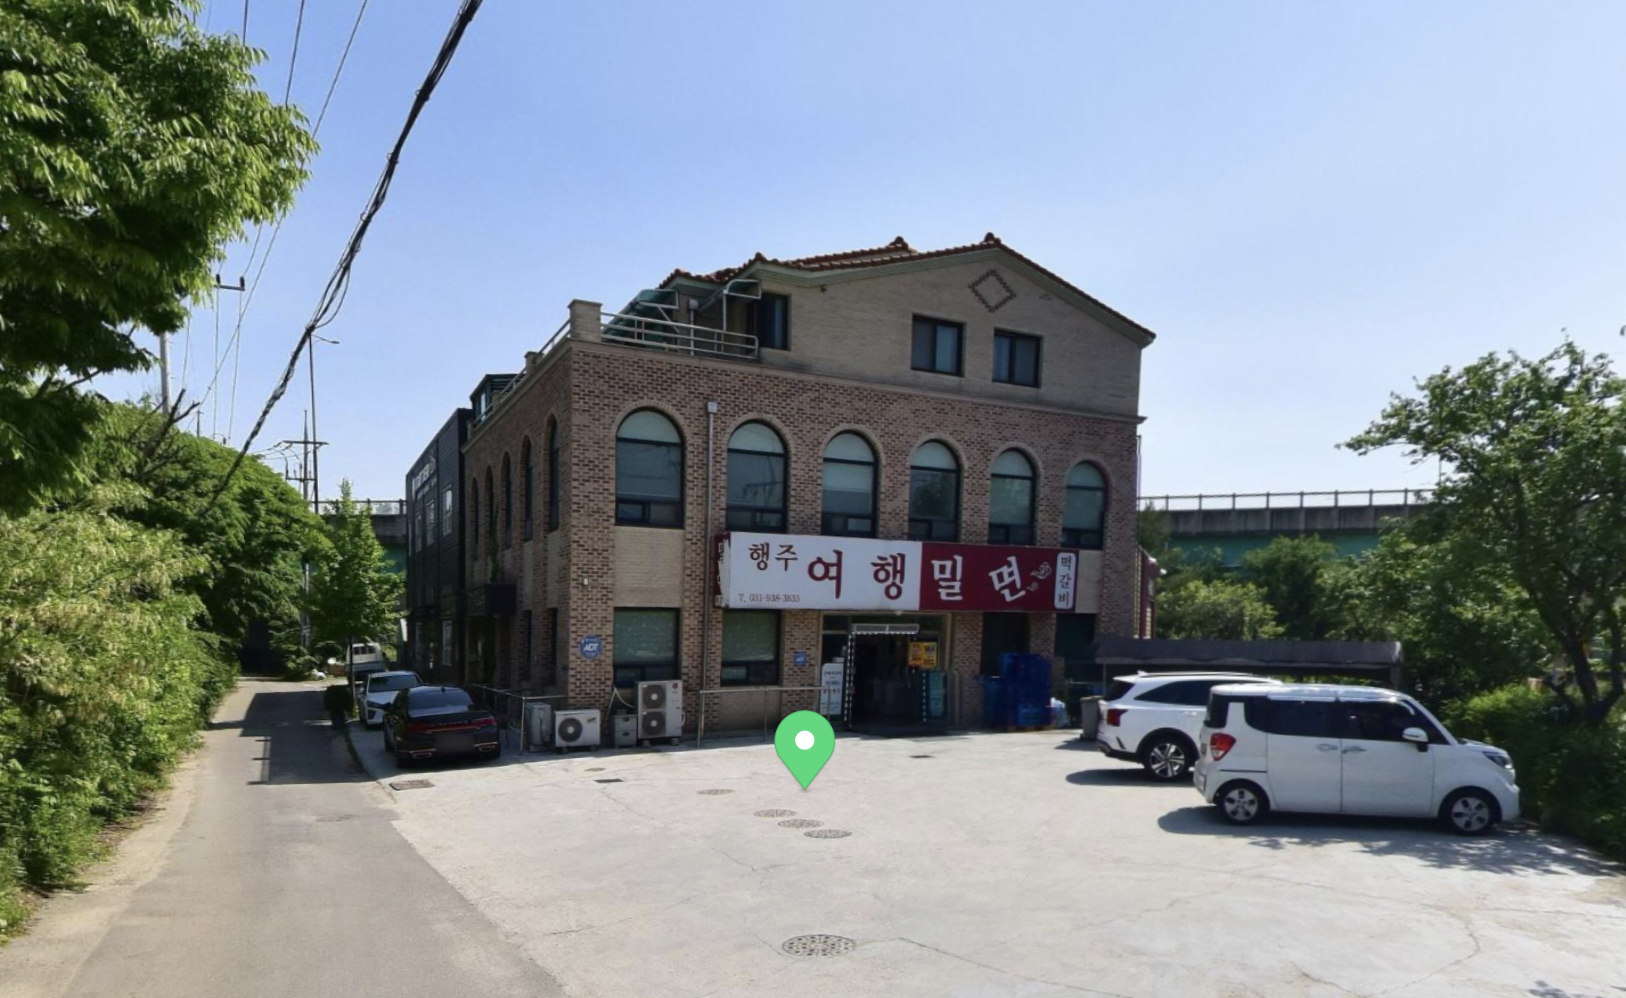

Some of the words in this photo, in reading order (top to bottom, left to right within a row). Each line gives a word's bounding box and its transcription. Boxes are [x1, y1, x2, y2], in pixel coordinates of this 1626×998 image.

[748, 541, 799, 572] 행주
[807, 549, 906, 601] 여행
[931, 554, 1026, 603] 밀면
